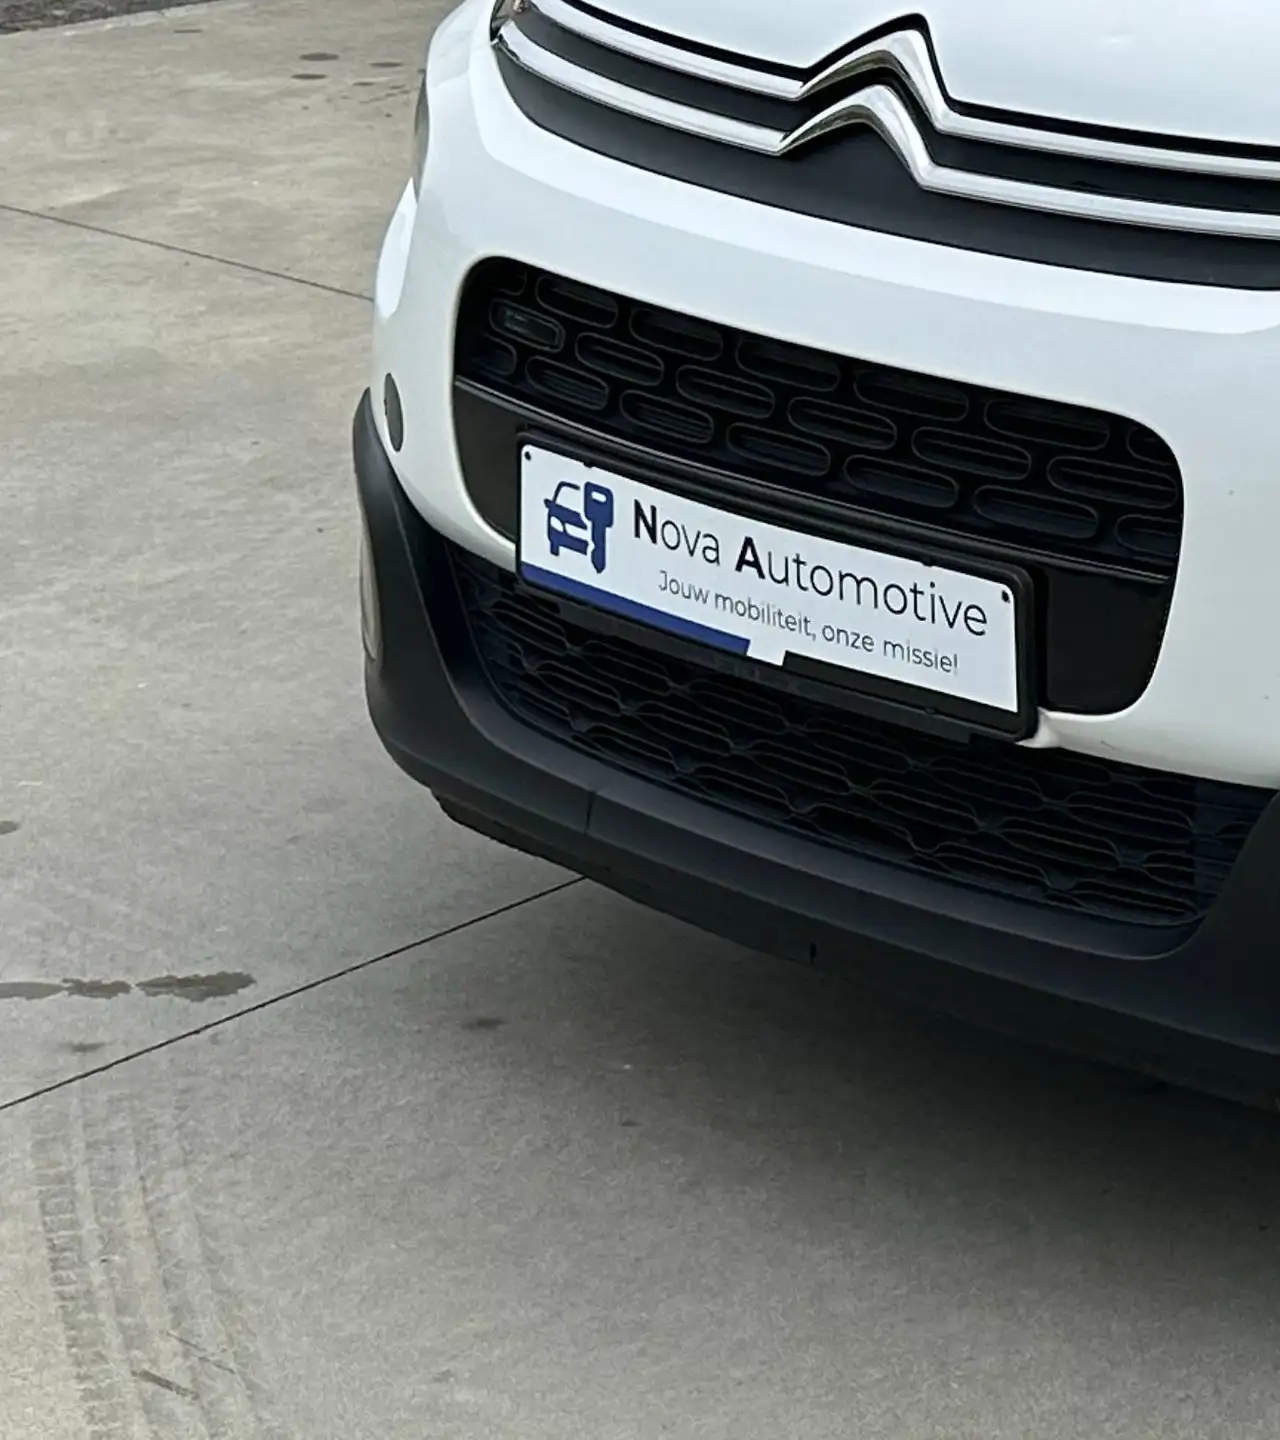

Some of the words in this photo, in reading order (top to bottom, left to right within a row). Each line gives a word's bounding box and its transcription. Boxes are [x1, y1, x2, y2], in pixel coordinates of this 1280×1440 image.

[633, 498, 721, 566] Nova
[734, 535, 988, 637] Automotive
[658, 569, 710, 605] Jouw
[714, 591, 817, 642] mobiliteit,
[821, 624, 875, 653] onze
[883, 638, 958, 676] missie!
